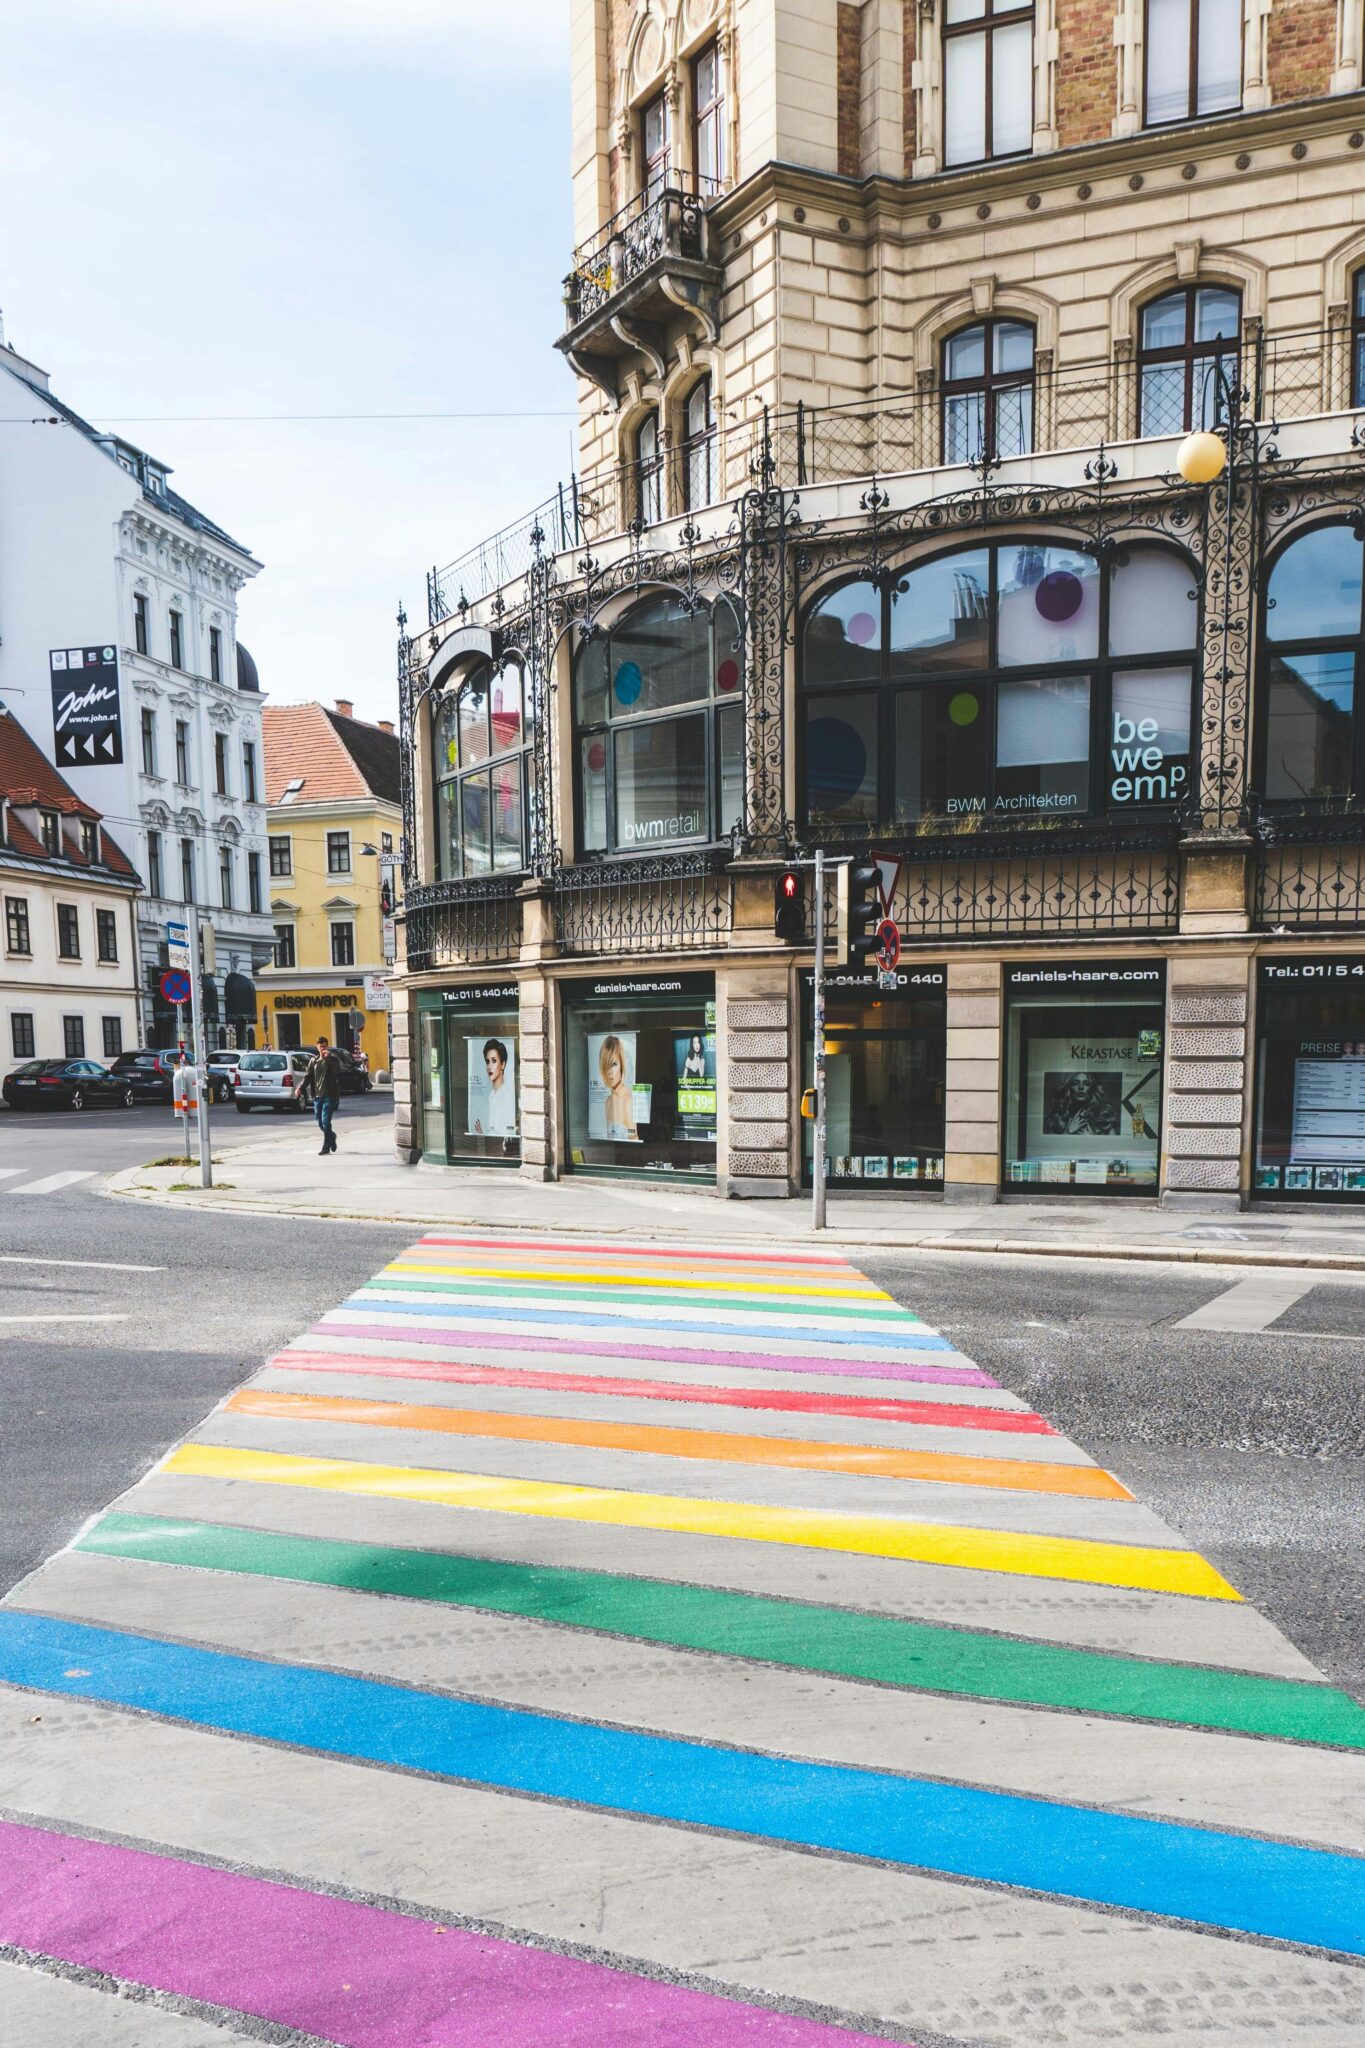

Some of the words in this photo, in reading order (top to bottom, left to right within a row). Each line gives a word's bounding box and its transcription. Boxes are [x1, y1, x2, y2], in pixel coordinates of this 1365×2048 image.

[56, 683, 117, 732] John
[68, 713, 118, 723] www.john.at
[1113, 711, 1159, 744] be
[1111, 746, 1164, 773] we
[947, 797, 986, 813] BWM
[994, 792, 1078, 809] Architekten
[624, 809, 700, 841] bwmretail
[1011, 970, 1159, 982] daniels-haare.com
[1265, 966, 1299, 977] Tel.:
[911, 974, 943, 985] 440
[594, 981, 682, 994] daniels-haare.com
[274, 993, 358, 1009] eisenwaren
[1071, 1045, 1134, 1060] KÉRASTASE
[1300, 1042, 1342, 1053] PREISE
